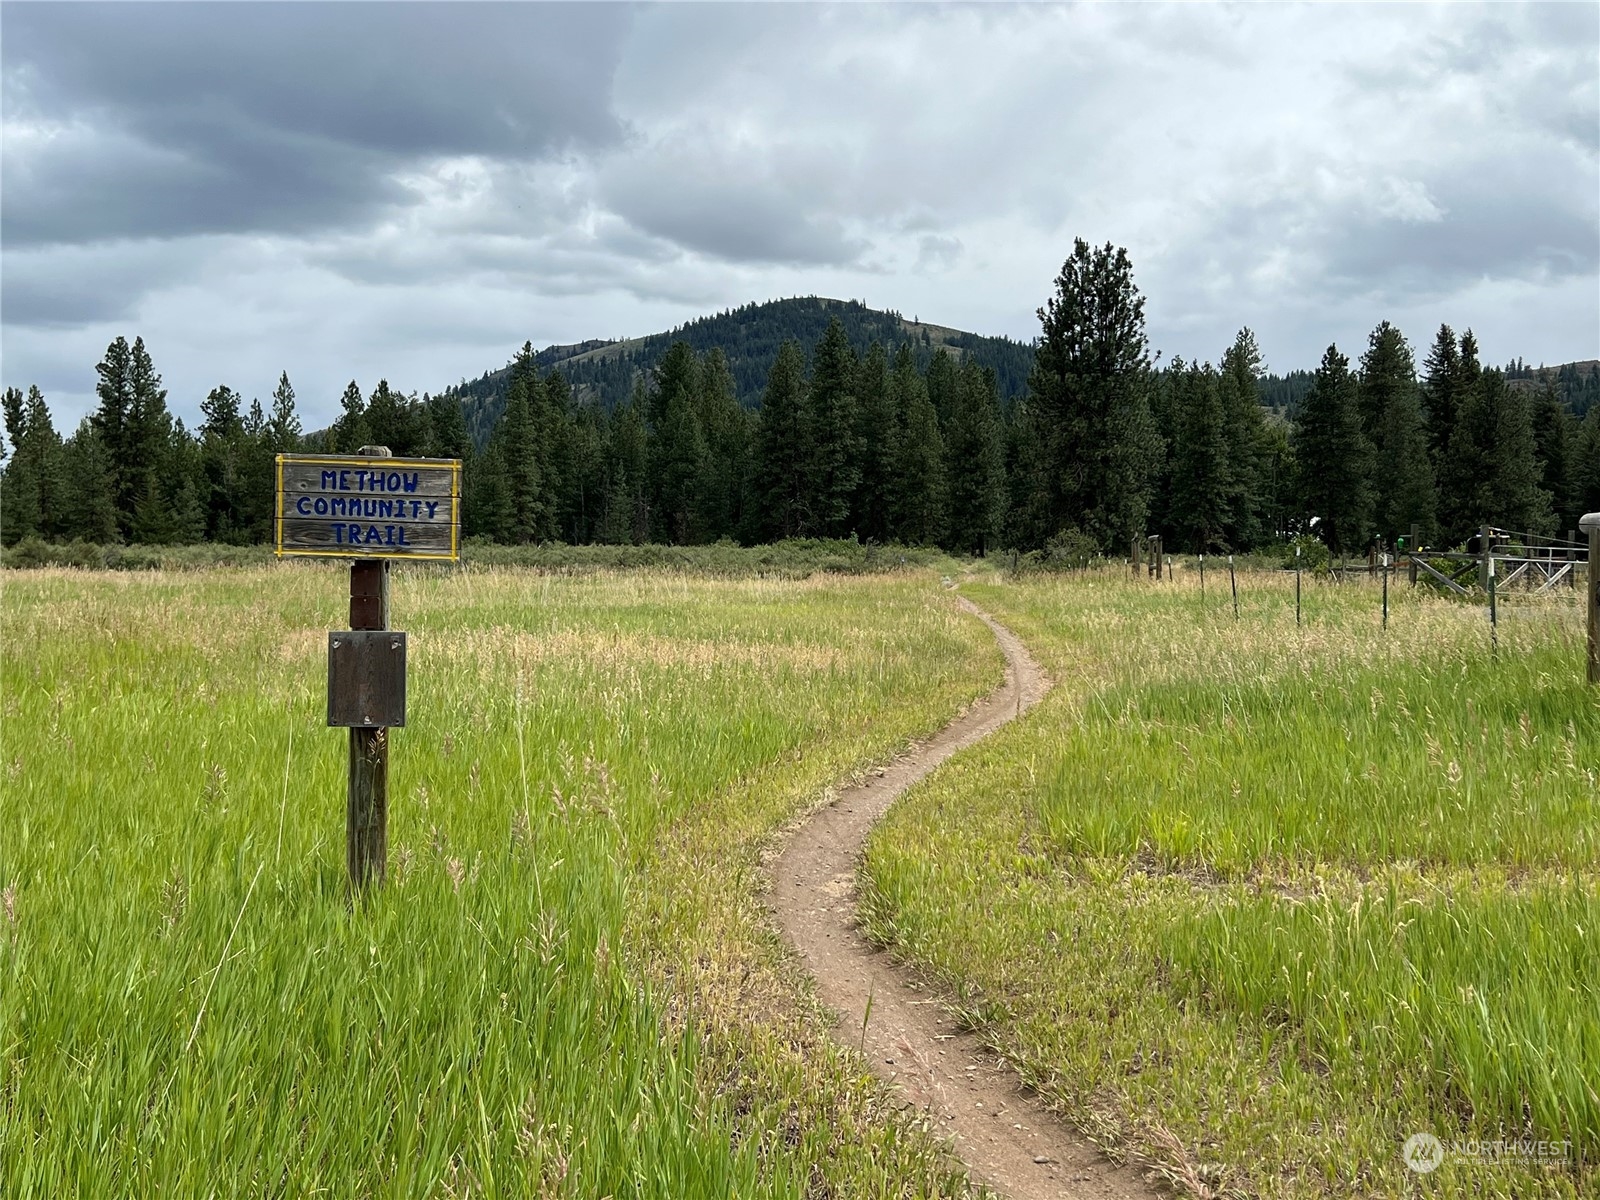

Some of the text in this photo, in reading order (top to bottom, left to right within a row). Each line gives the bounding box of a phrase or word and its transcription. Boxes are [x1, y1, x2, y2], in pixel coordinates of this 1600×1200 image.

[321, 470, 419, 492] METHOW
[296, 496, 439, 519] COMMUNITY
[330, 523, 411, 546] TRAIL
